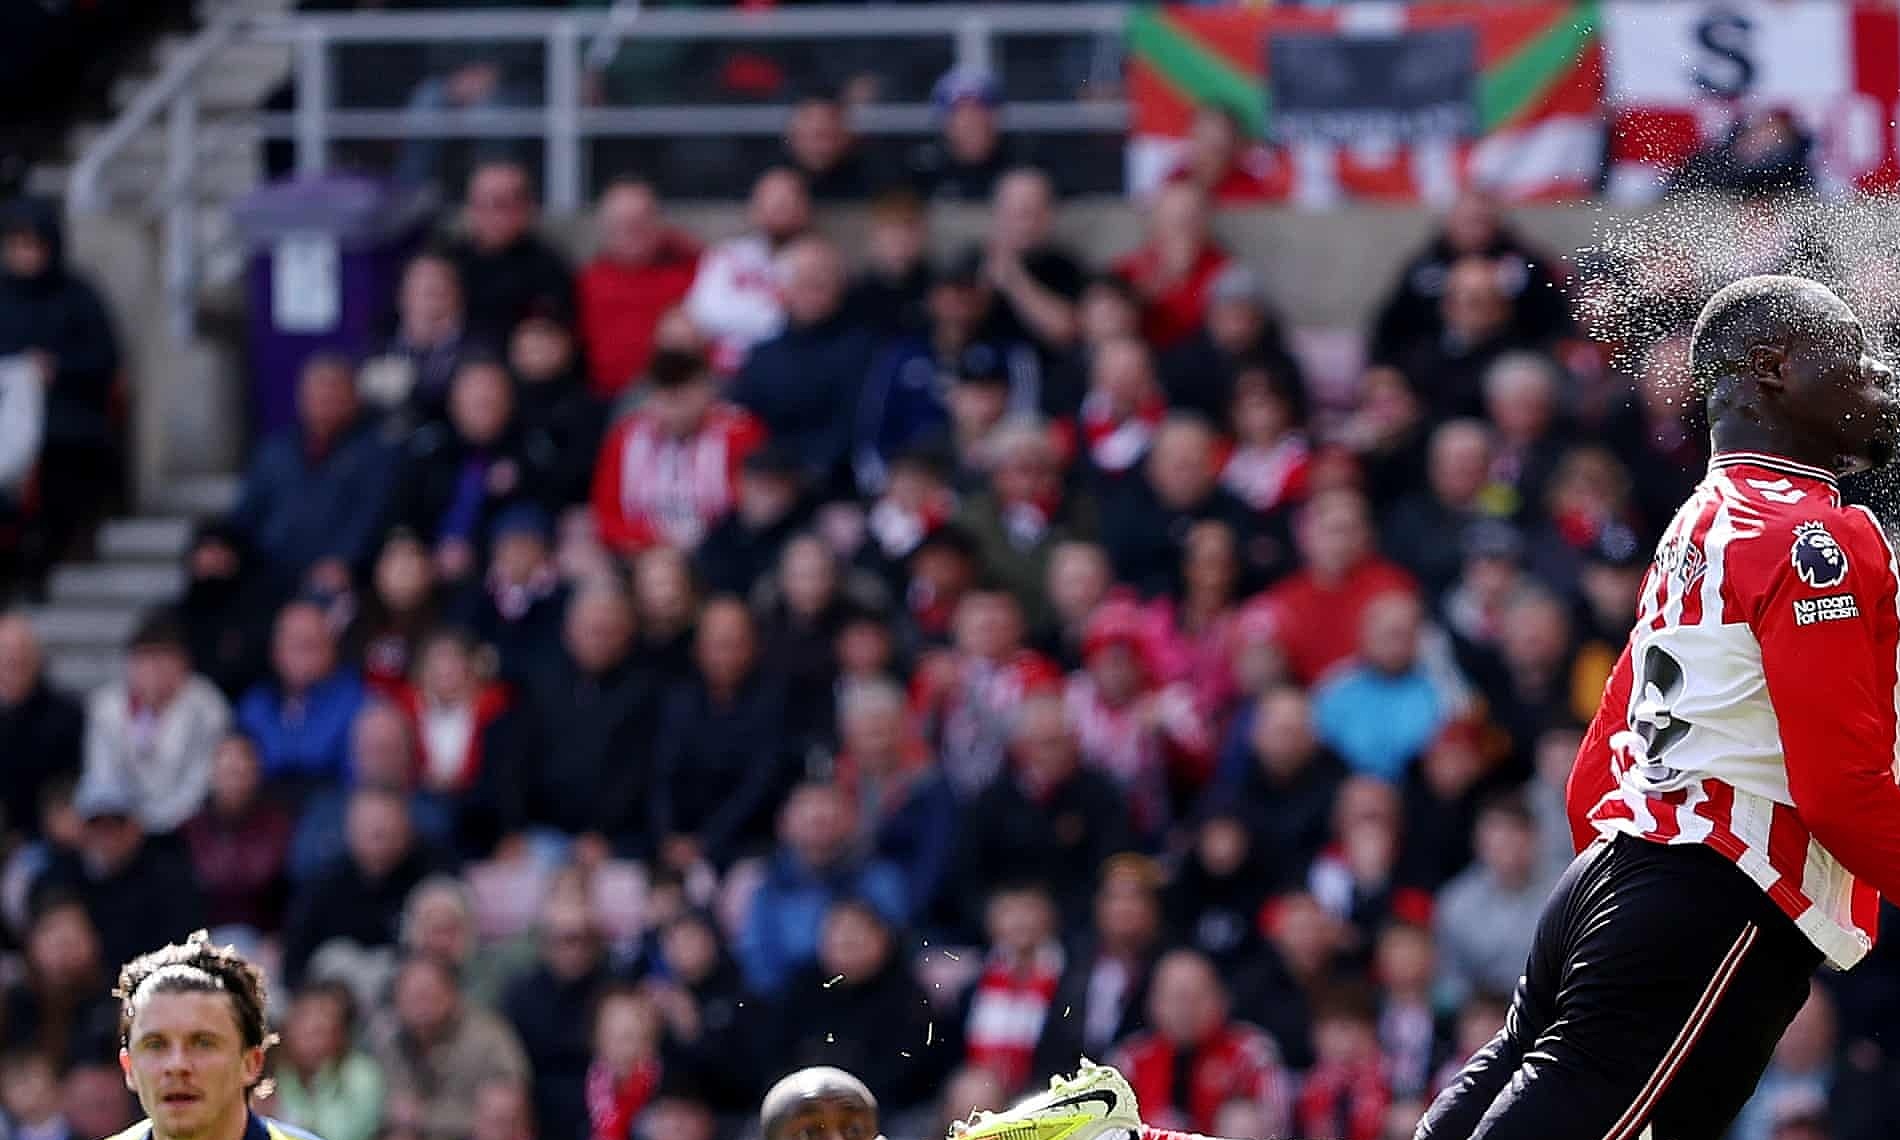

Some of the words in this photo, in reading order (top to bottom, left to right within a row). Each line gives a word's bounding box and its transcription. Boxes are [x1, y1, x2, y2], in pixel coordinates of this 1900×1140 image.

[1793, 600, 1816, 612] No
[1817, 595, 1854, 608] room
[1795, 611, 1817, 626] for
[1818, 606, 1860, 621] racism
